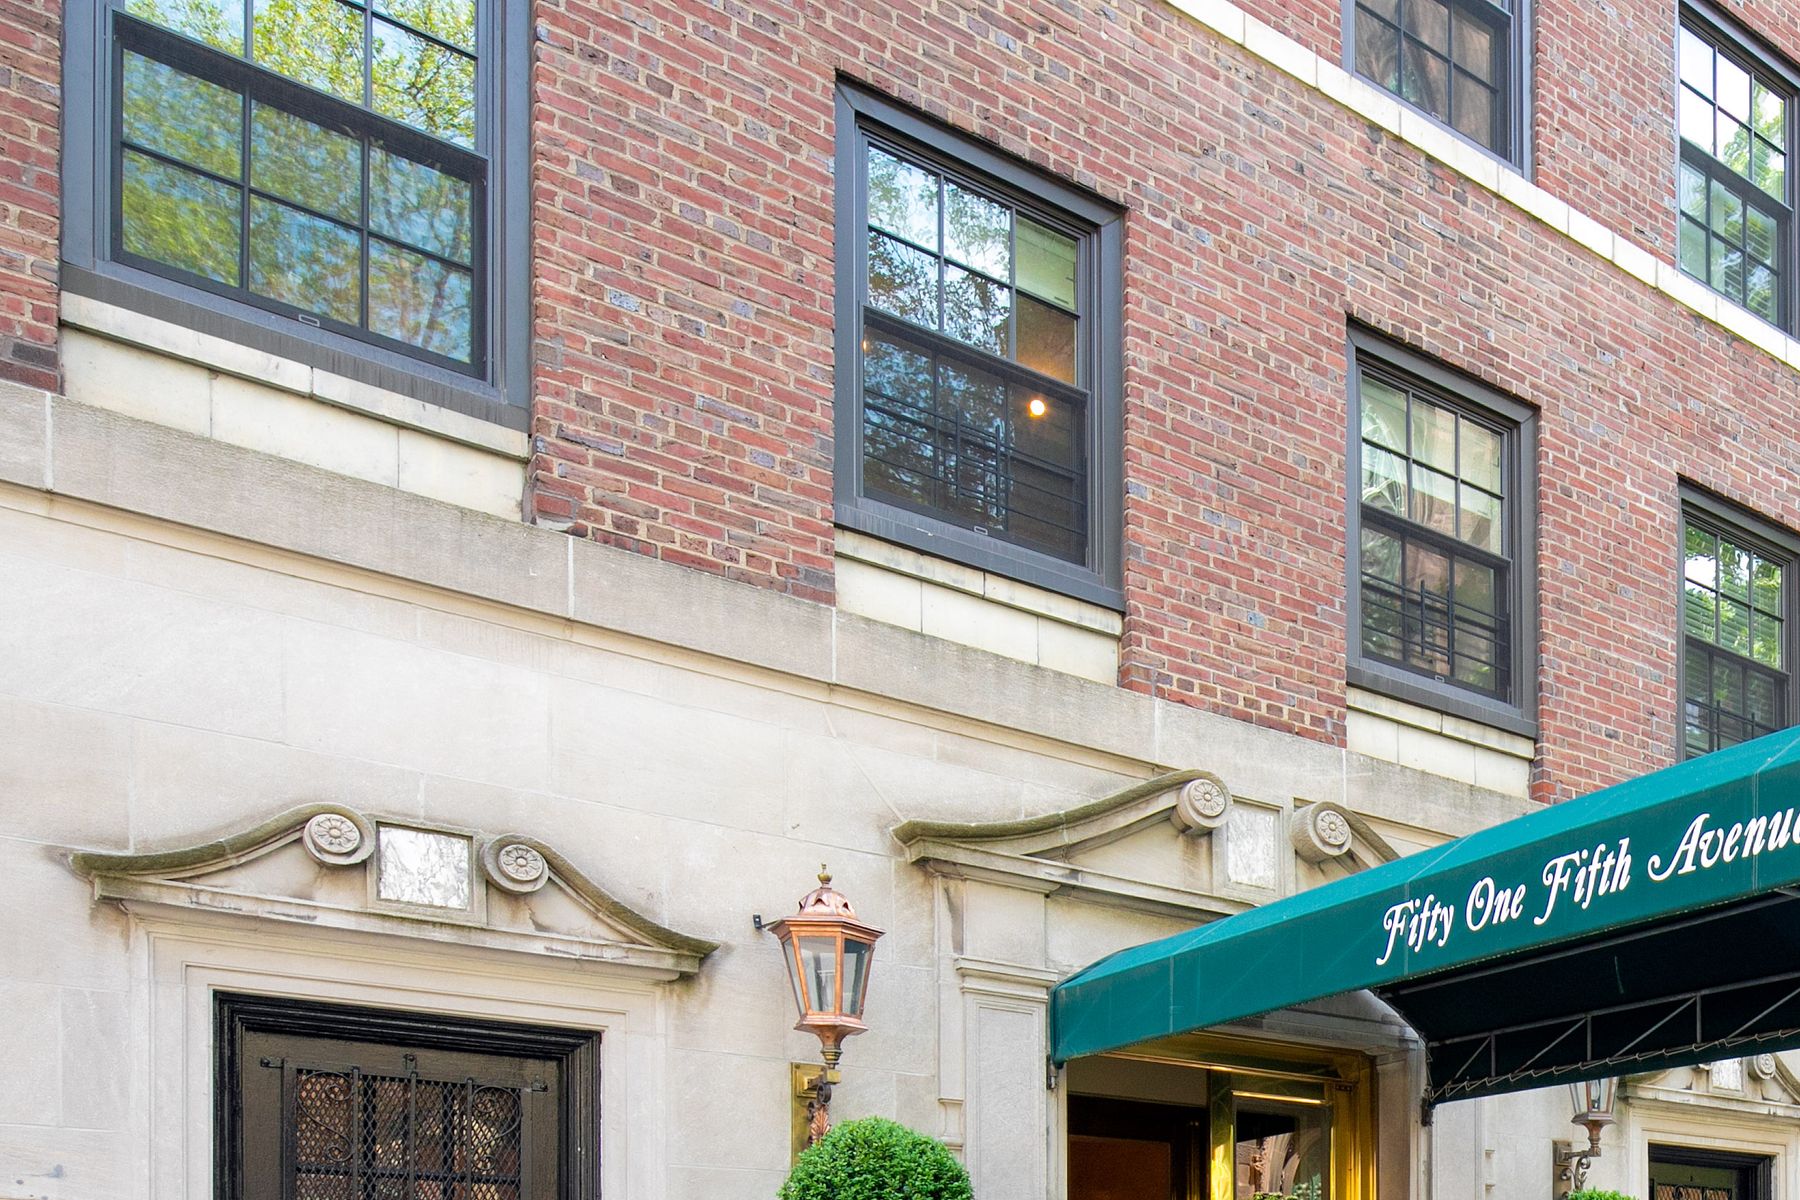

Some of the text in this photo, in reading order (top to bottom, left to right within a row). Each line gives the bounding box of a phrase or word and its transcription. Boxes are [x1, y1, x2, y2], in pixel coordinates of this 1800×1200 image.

[1375, 894, 1455, 966] Fifty
[1466, 877, 1526, 932] One
[1533, 837, 1632, 925] Fifth
